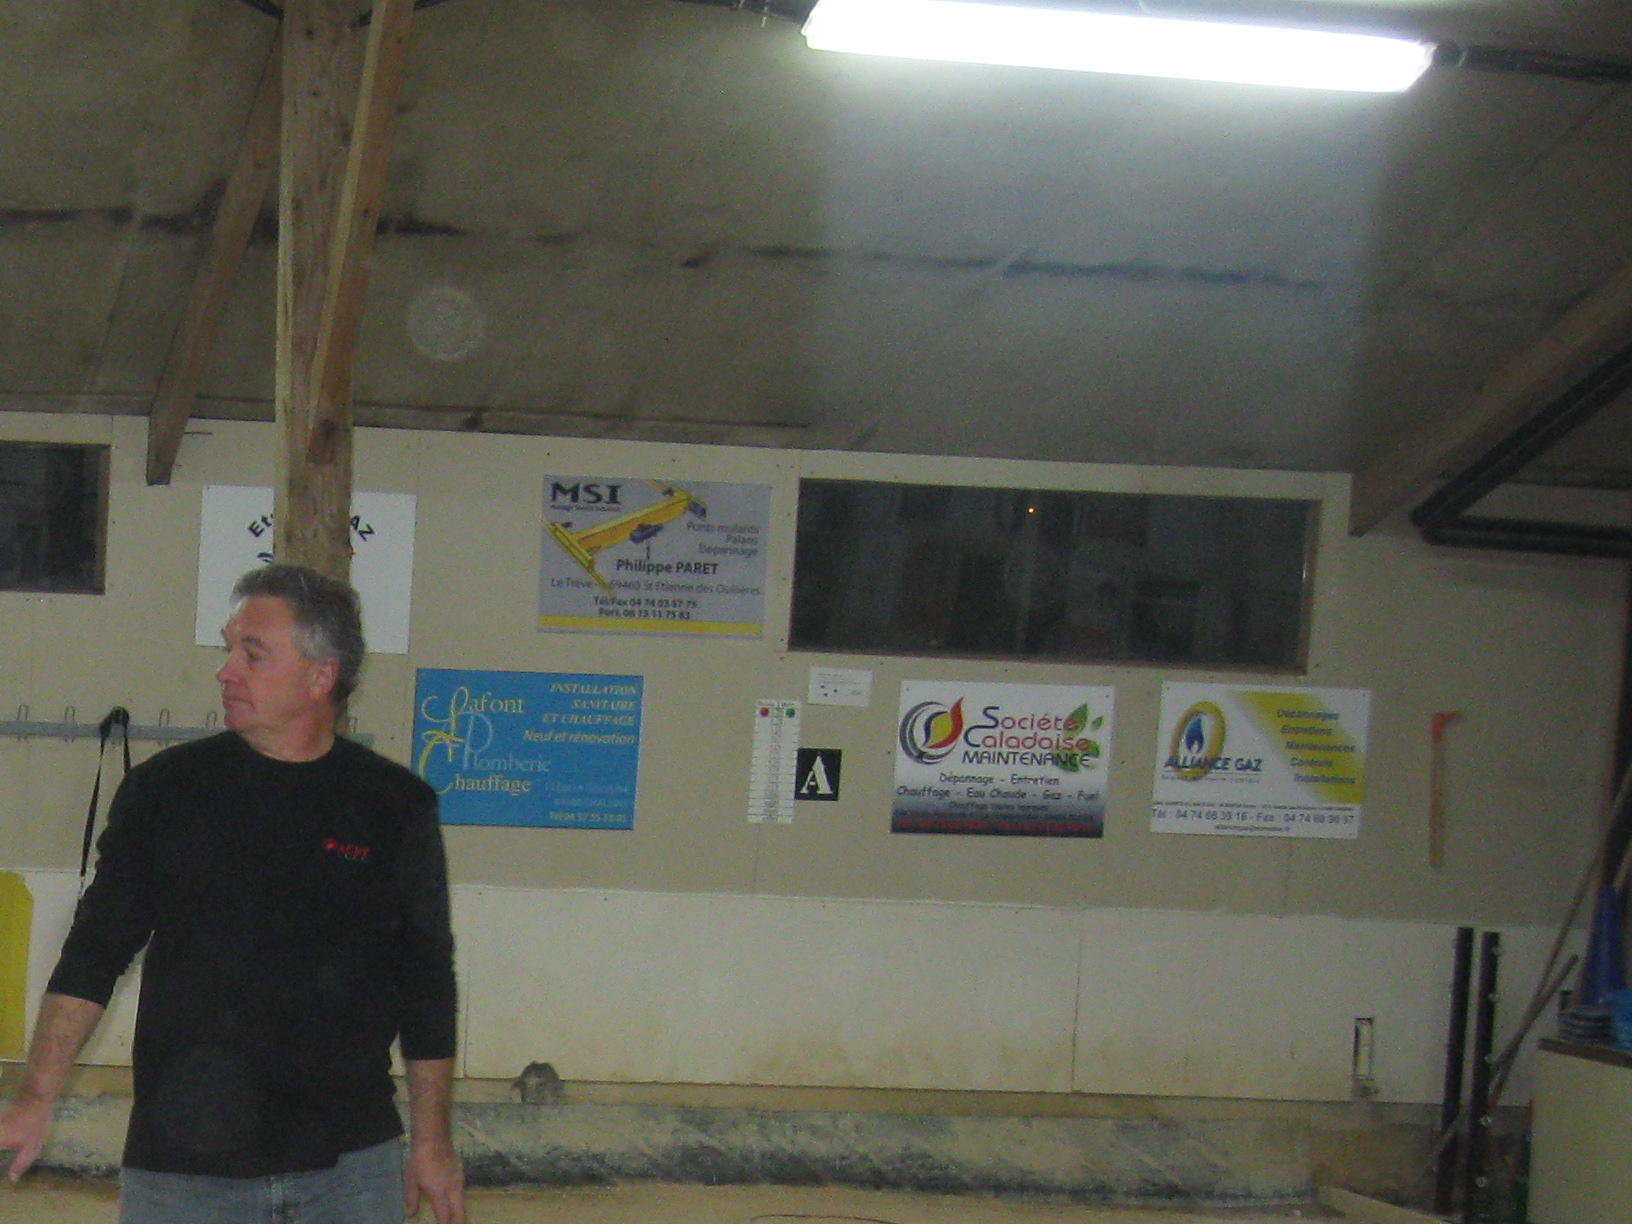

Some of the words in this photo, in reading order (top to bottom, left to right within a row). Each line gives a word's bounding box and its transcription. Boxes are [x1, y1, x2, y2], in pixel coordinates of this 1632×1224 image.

[551, 482, 623, 505] MSI
[248, 513, 274, 538] Et
[616, 559, 673, 576] Philippe
[676, 561, 719, 575] PARET
[549, 682, 637, 695] INSTALLATION
[572, 699, 636, 711] SANITAIRE
[542, 713, 560, 724] ET
[561, 714, 636, 727] CHAUFFAGE
[523, 729, 554, 743] Neuf
[555, 731, 567, 743] et
[569, 731, 635, 745] rénovation
[964, 726, 1091, 750] Caladoise
[962, 751, 1091, 767] MAINTENANCE
[1164, 756, 1232, 772] ALLIANCE
[1234, 758, 1263, 772] GAZ
[799, 754, 833, 795] A
[939, 772, 995, 785] Dépannage
[1010, 774, 1060, 785] Entretien
[896, 785, 950, 800] Chauffage
[967, 787, 986, 799] Eau
[989, 788, 1028, 799] Chaude
[1042, 790, 1062, 800] Gaz
